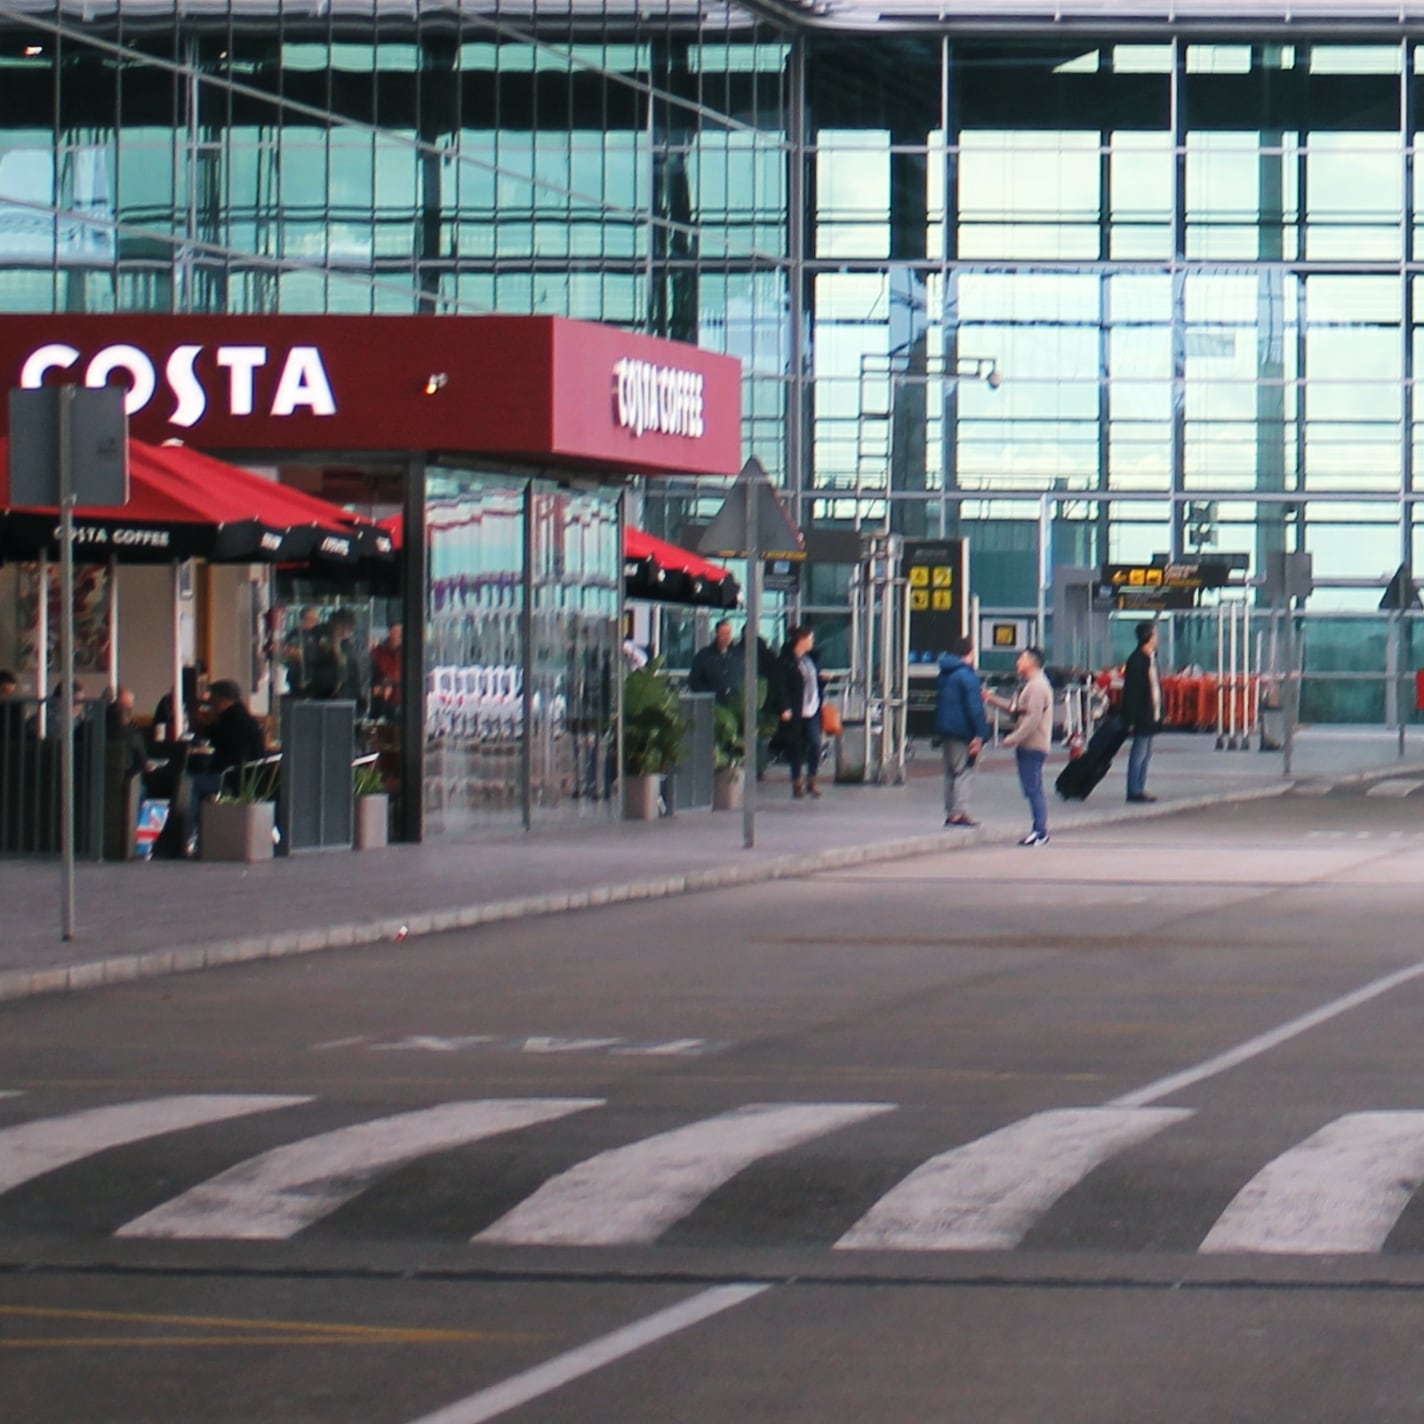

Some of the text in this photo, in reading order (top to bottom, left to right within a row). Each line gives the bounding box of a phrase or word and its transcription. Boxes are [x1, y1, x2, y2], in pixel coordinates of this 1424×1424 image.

[21, 344, 337, 428] COSTA
[613, 356, 705, 438] COSTA COFFEE
[112, 528, 171, 547] COFFEE
